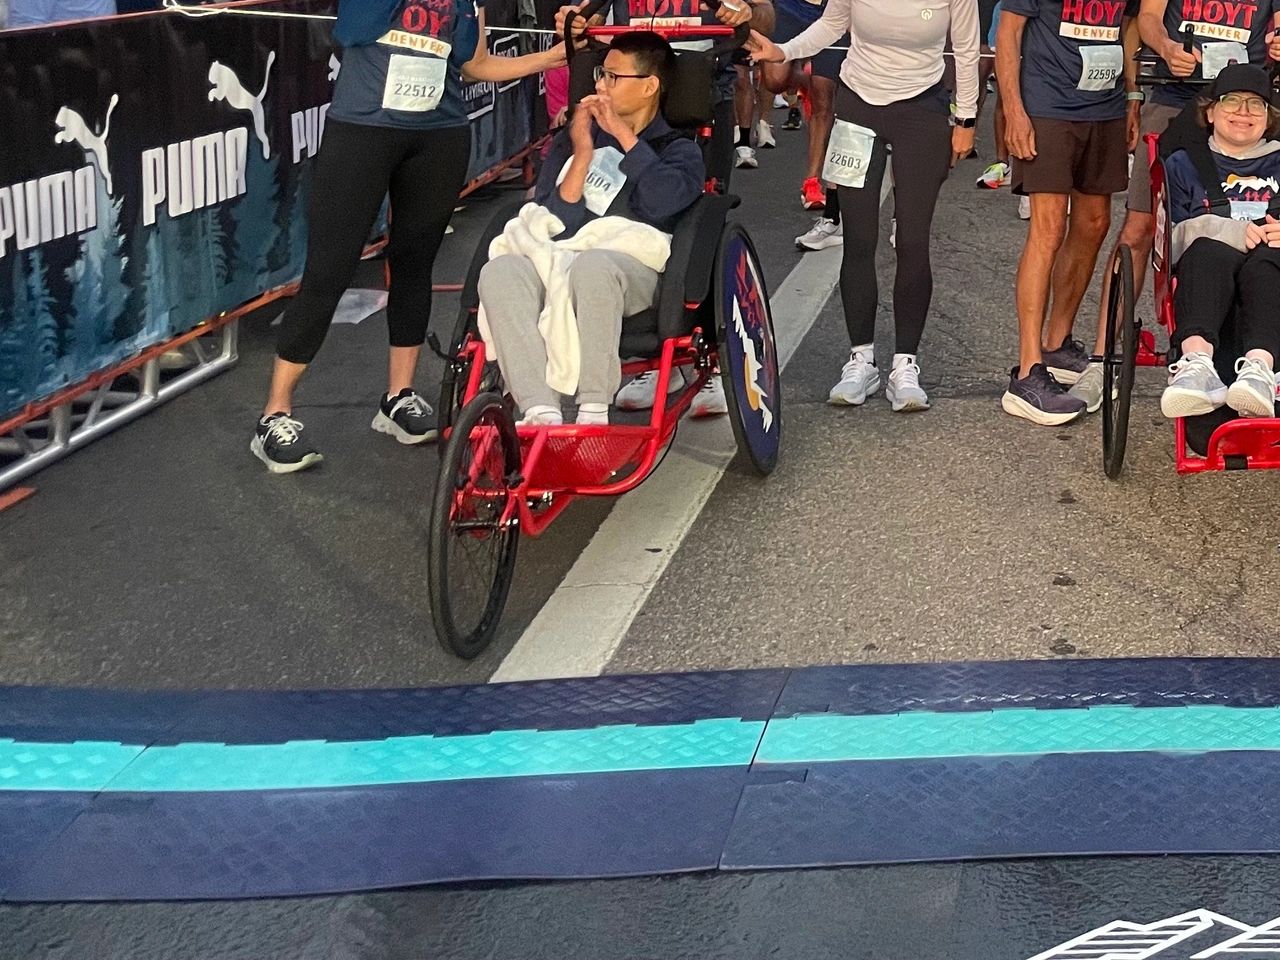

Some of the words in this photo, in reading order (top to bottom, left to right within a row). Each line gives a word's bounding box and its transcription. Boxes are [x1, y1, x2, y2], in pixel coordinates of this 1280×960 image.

[403, 5, 450, 37] OY
[390, 32, 445, 54] DENVER
[1088, 69, 1117, 80] 22598
[394, 82, 436, 98] 22512
[291, 102, 331, 163] PU
[829, 151, 861, 170] 22603
[142, 126, 248, 226] PUMA
[0, 165, 96, 258] PUMA
